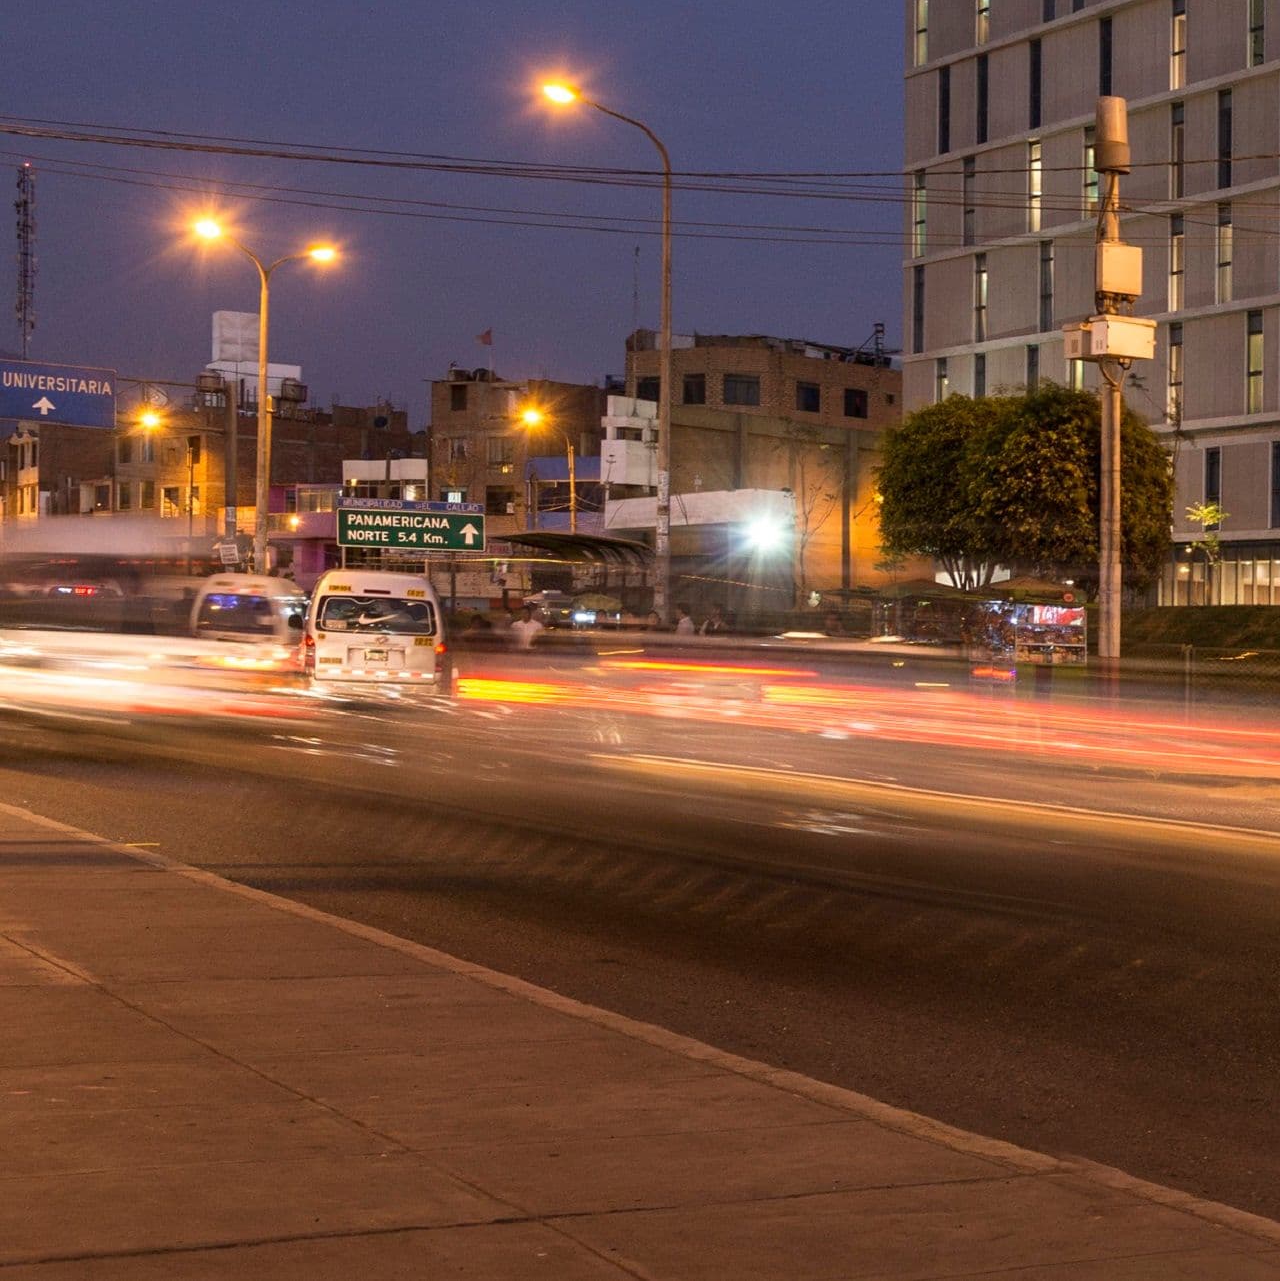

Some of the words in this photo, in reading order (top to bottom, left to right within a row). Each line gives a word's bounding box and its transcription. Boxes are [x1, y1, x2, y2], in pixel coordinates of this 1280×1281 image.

[2, 371, 112, 396] UNIVERSITARIA
[342, 498, 403, 509] MUNICIPALIDAD
[446, 503, 479, 512] CALLAO
[347, 514, 450, 529] PANAMERICANA
[347, 530, 389, 542] NORTE
[398, 532, 417, 543] 5.4
[423, 533, 448, 544] Km.
